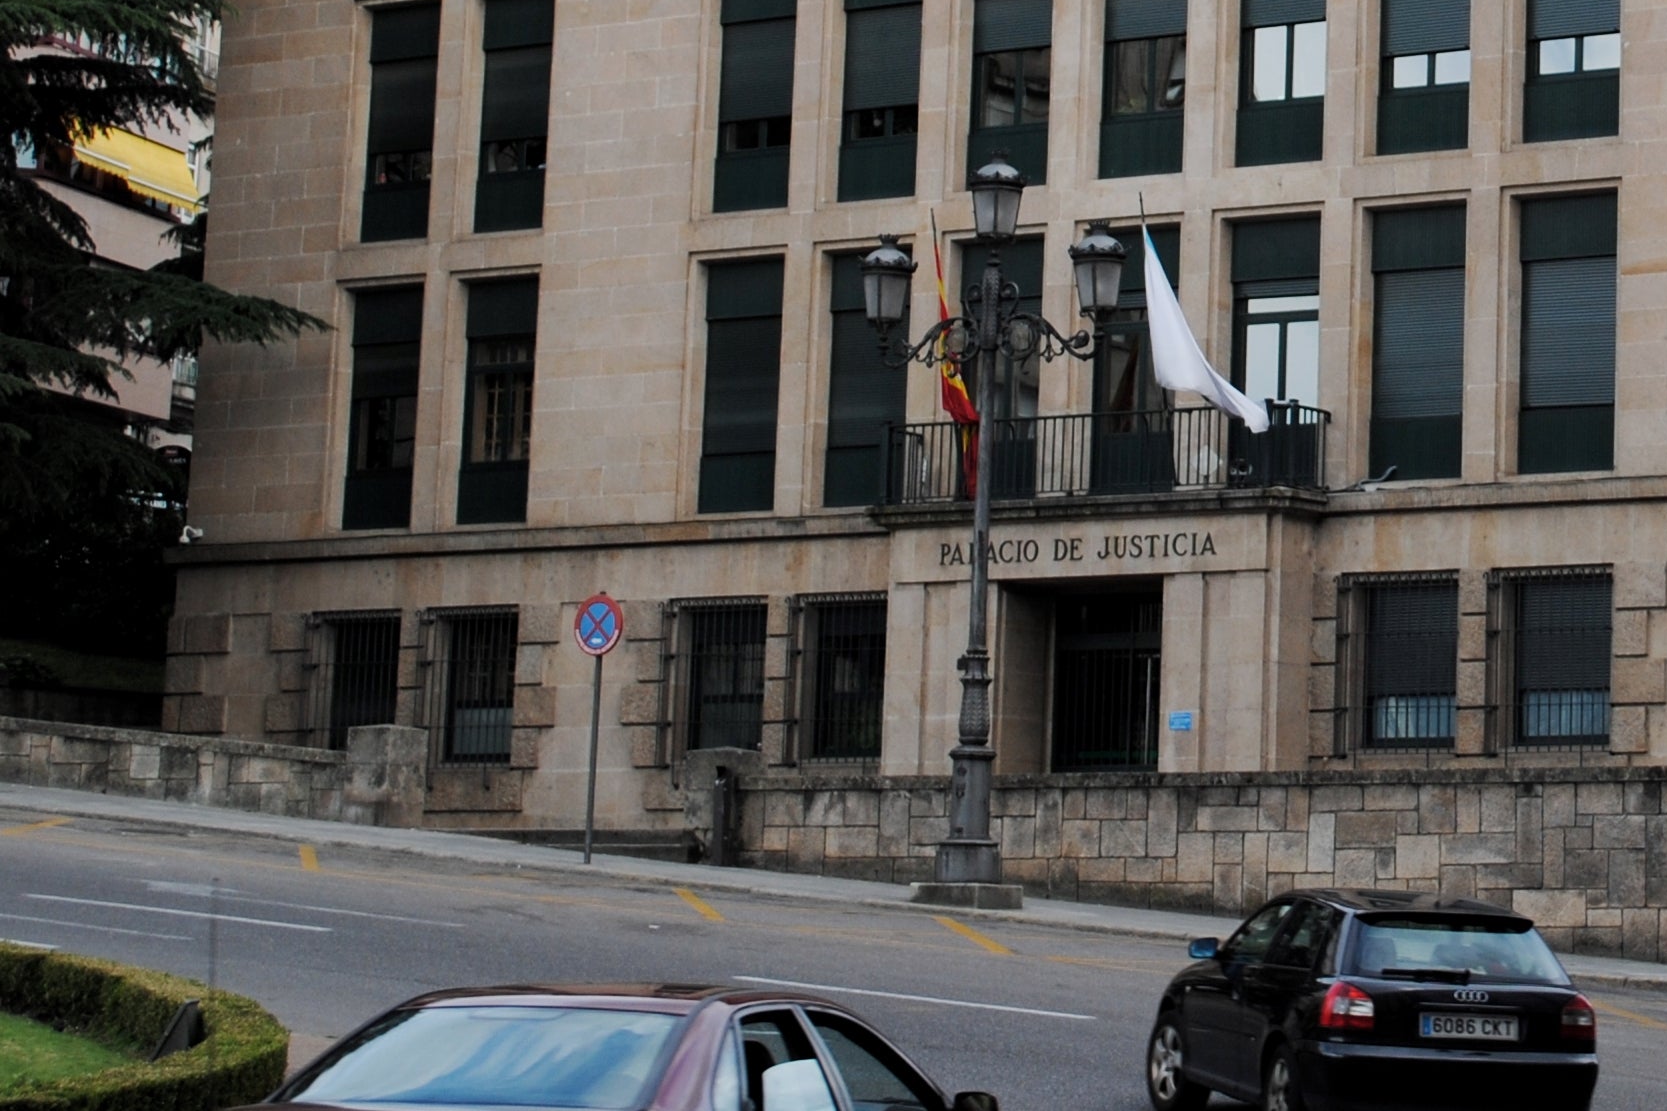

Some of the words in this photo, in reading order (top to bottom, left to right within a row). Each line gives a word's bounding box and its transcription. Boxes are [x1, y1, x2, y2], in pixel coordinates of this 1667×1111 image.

[1053, 538, 1084, 562] DE
[1097, 532, 1218, 560] JUSTICIA
[1432, 1017, 1476, 1035] 6086
[1481, 1019, 1513, 1037] CKT
